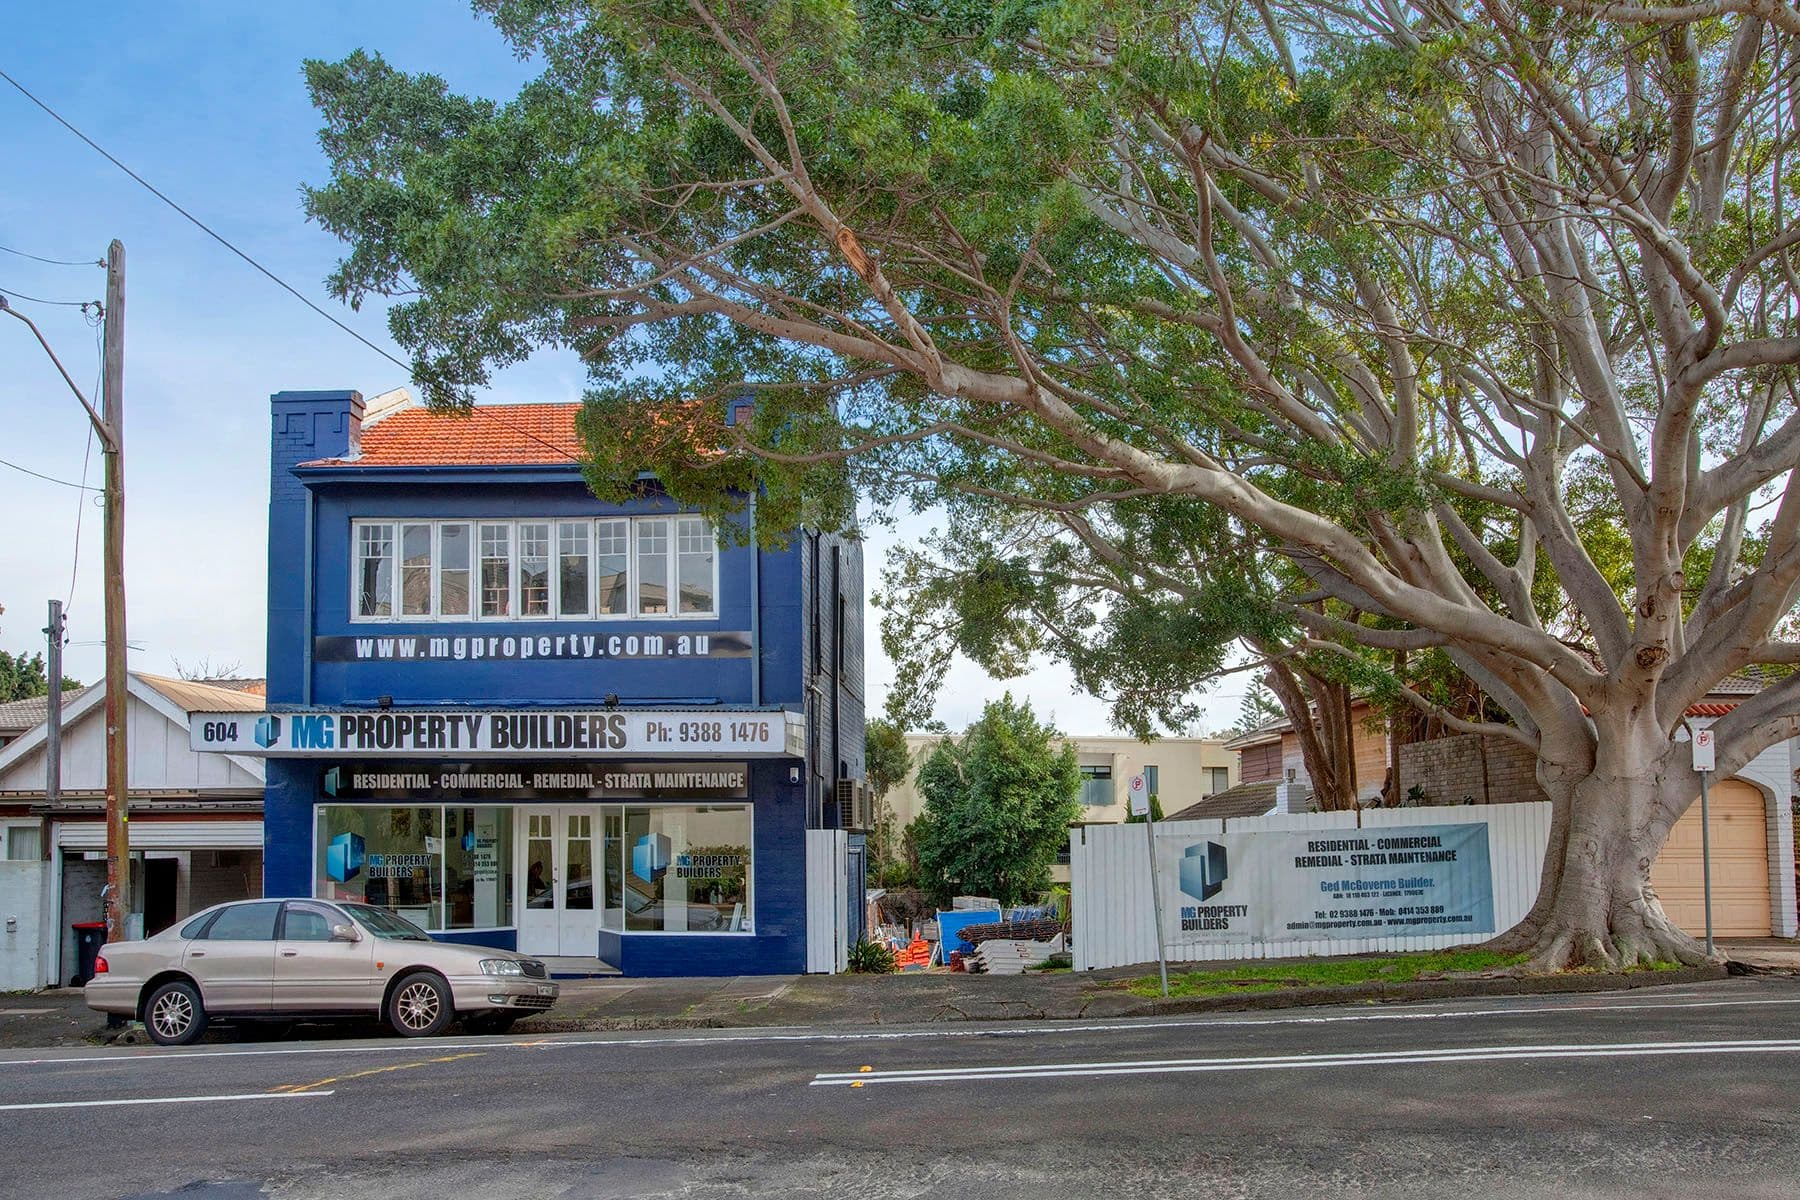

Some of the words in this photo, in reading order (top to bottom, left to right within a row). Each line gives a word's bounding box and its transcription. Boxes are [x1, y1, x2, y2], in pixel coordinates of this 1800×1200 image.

[355, 634, 710, 659] www.mgproperty.com.au
[203, 721, 239, 742] 604
[291, 715, 334, 749] MG
[340, 715, 483, 749] PROPERTY
[490, 715, 628, 750] BUILDERS
[646, 721, 673, 742] Ph:
[679, 721, 722, 742] 9388
[730, 721, 769, 742] 1476
[353, 773, 431, 789] RESIDENTIAL
[441, 773, 524, 789] COMMERCIAL
[533, 773, 595, 789] REMEDIAL
[604, 773, 652, 788] STRATA
[654, 773, 744, 788] MAINTENANCE
[1308, 838, 1370, 853] RESIDENTIAL
[1377, 836, 1442, 850] COMMERCIAL
[369, 855, 383, 865] MG
[385, 855, 432, 865] PROPERTY
[677, 855, 690, 866] MG
[693, 855, 741, 866] PROPERTY
[1295, 855, 1343, 868] REMEDIAL
[1351, 853, 1387, 866] STRATA
[1388, 850, 1457, 865] MAINTENANCE
[369, 866, 413, 877] BUILDERS
[677, 867, 722, 878] BUILDERS
[1320, 880, 1340, 892] Ged
[1341, 879, 1396, 891] McGoverne
[1399, 877, 1435, 889] Builder.
[1181, 906, 1196, 918] MG
[1197, 904, 1248, 918] PROPERTY
[1314, 910, 1327, 919] Tel:
[1329, 910, 1339, 918] 02
[1340, 909, 1358, 918] 9388
[1359, 908, 1374, 917] 1476
[1415, 905, 1429, 914] 353
[1181, 918, 1229, 931] BUILDERS
[1387, 914, 1473, 926] www.mgproperty.com.au
